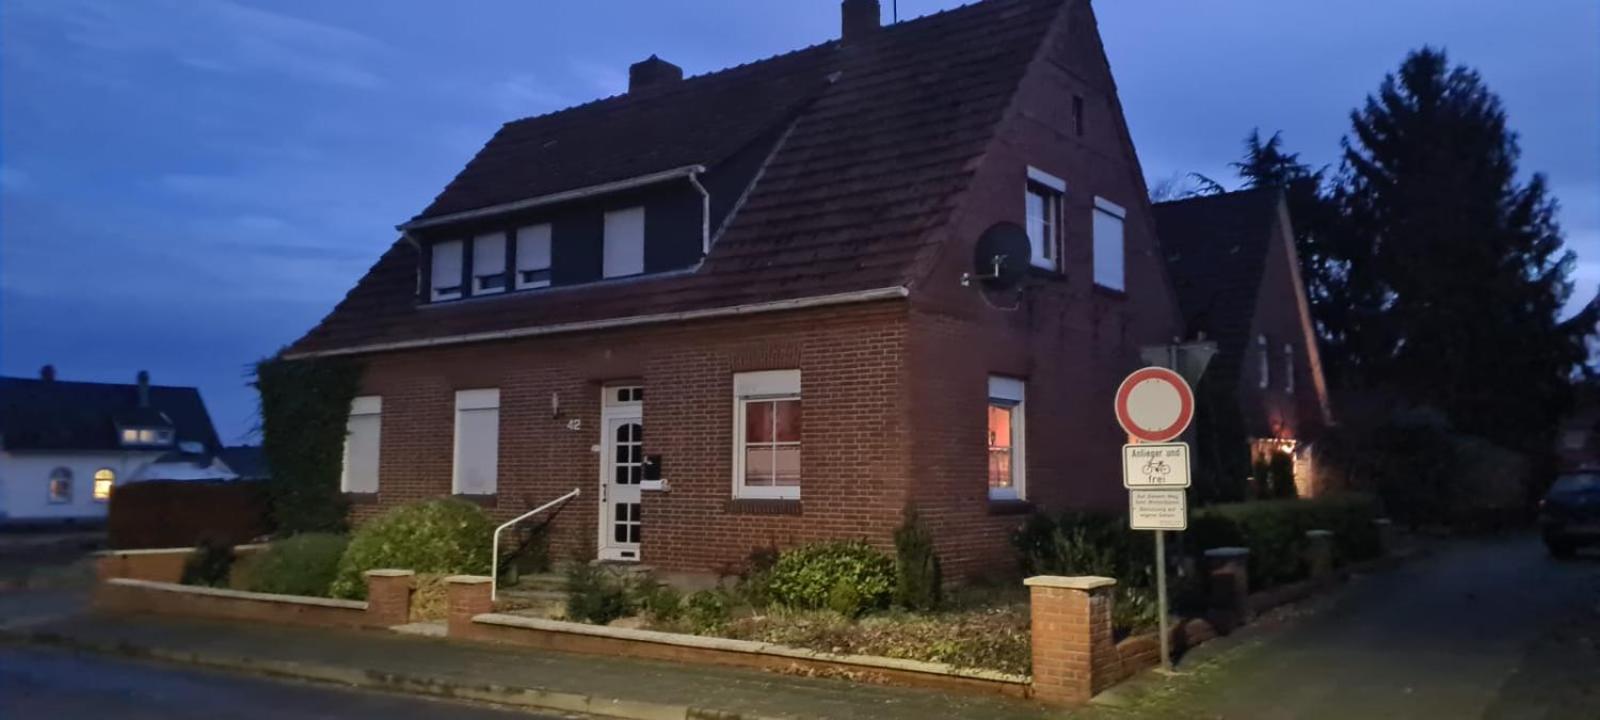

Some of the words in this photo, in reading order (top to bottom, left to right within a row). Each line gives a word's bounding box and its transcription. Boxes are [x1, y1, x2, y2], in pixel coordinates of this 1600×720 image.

[566, 419, 581, 430] 42
[1132, 448, 1162, 458] Anlieger
[1167, 448, 1180, 457] und
[1149, 475, 1166, 483] frei
